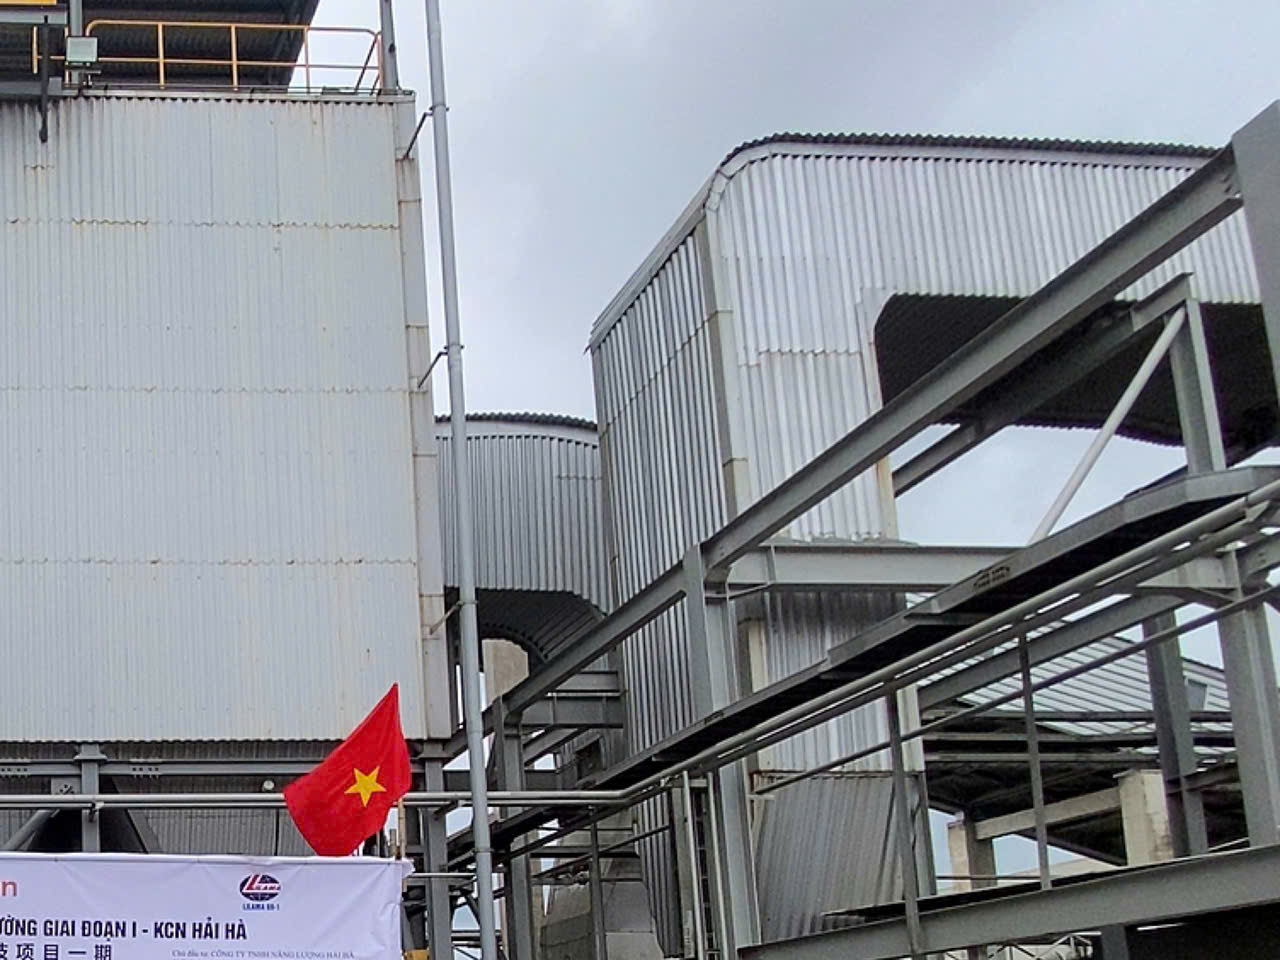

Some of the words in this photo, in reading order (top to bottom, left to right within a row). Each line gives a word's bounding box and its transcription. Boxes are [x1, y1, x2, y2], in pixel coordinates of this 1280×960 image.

[43, 919, 76, 937] GIAI
[81, 920, 127, 941] ĐOẠN
[132, 921, 137, 938] I
[154, 921, 187, 939] KCN
[192, 915, 219, 939] HẢI
[225, 917, 247, 940] HÀ
[236, 950, 246, 958] TY
